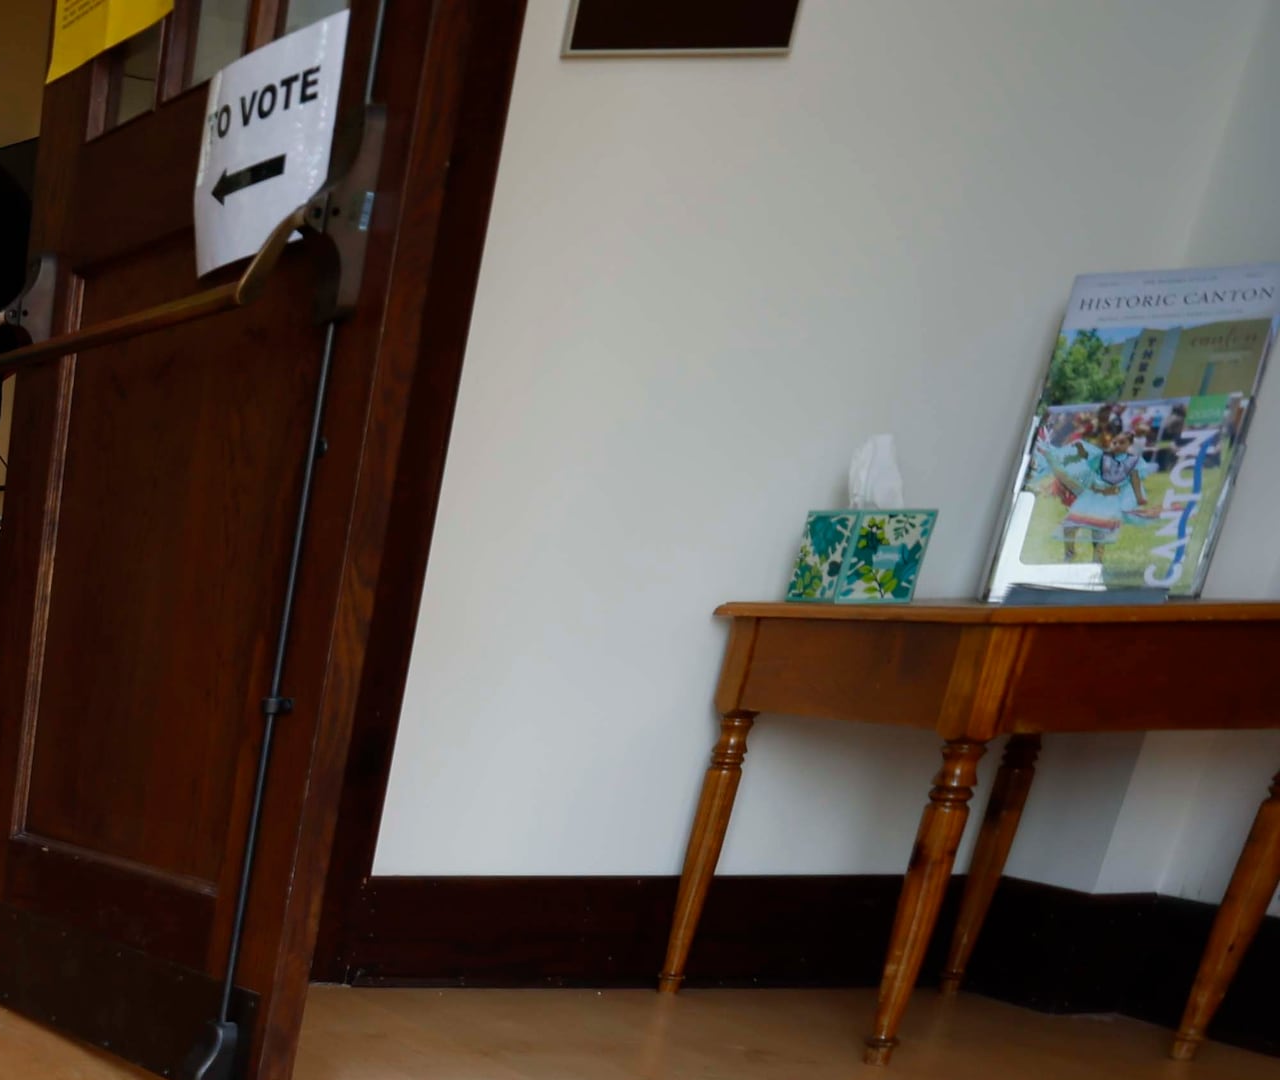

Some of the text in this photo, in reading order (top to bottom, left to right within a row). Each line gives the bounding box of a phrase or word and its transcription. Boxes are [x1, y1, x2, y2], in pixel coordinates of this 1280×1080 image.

[240, 65, 321, 128] VOTE
[1079, 286, 1276, 312] HISTORIC CANTON
[1131, 336, 1157, 398] THEAT
[1143, 428, 1221, 588] CANTON
